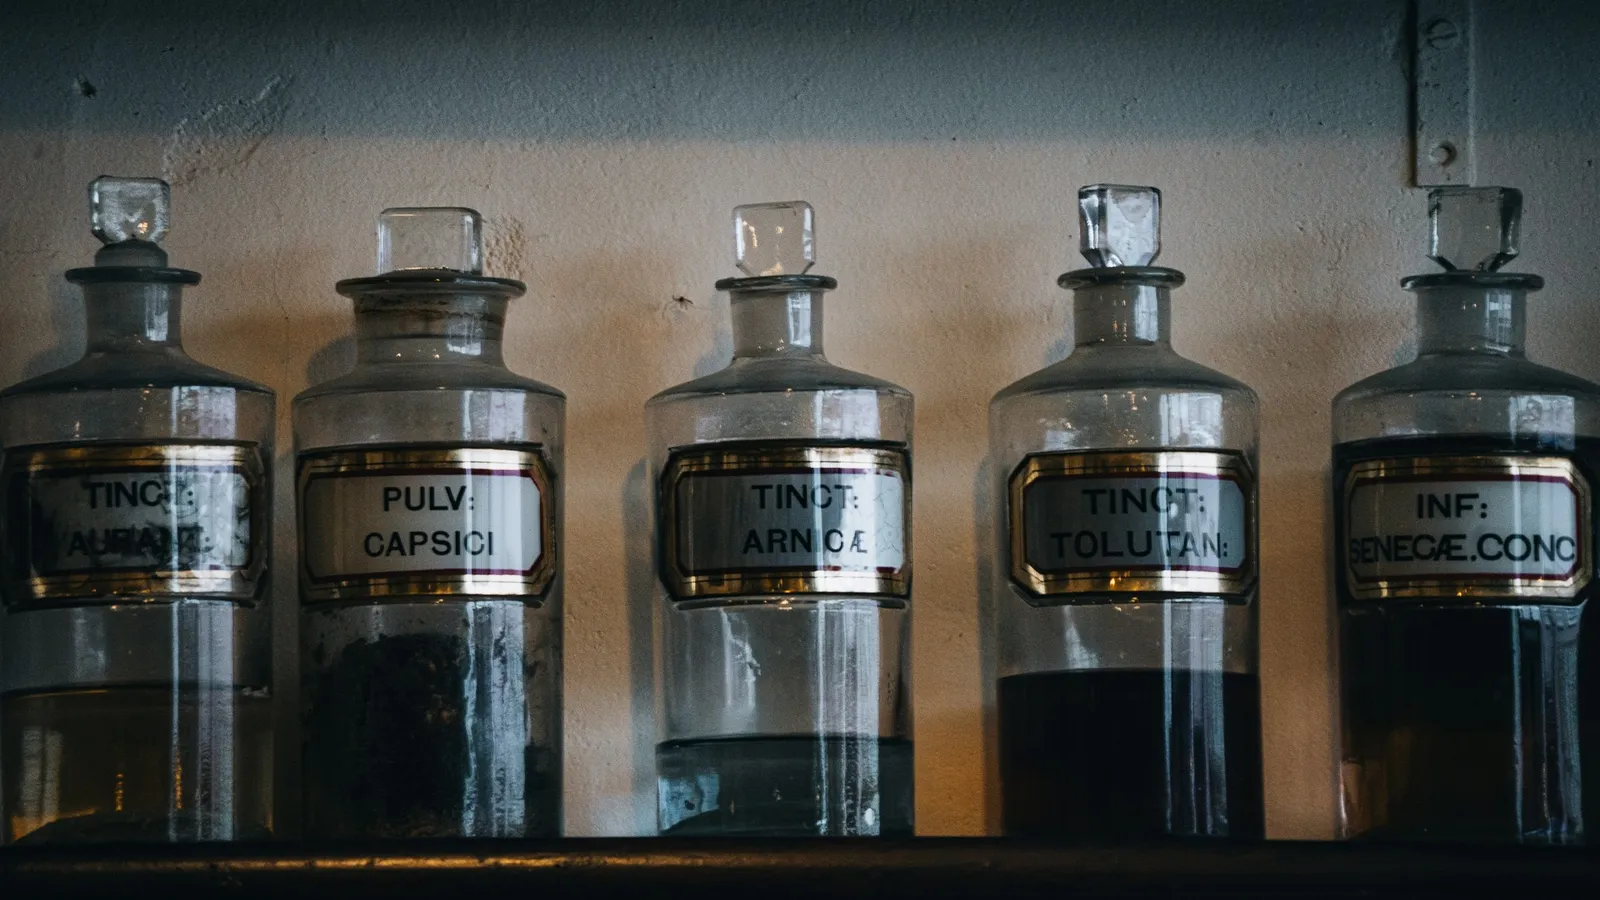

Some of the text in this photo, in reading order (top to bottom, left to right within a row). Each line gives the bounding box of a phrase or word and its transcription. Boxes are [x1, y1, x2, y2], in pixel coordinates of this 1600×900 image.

[383, 486, 475, 511] PULV:
[751, 484, 859, 509] TINCT:
[1082, 486, 1204, 515] TINCT:
[1417, 493, 1488, 519] INF:
[364, 531, 494, 557] CAPSICI
[1051, 530, 1229, 558] TOLUTAN:
